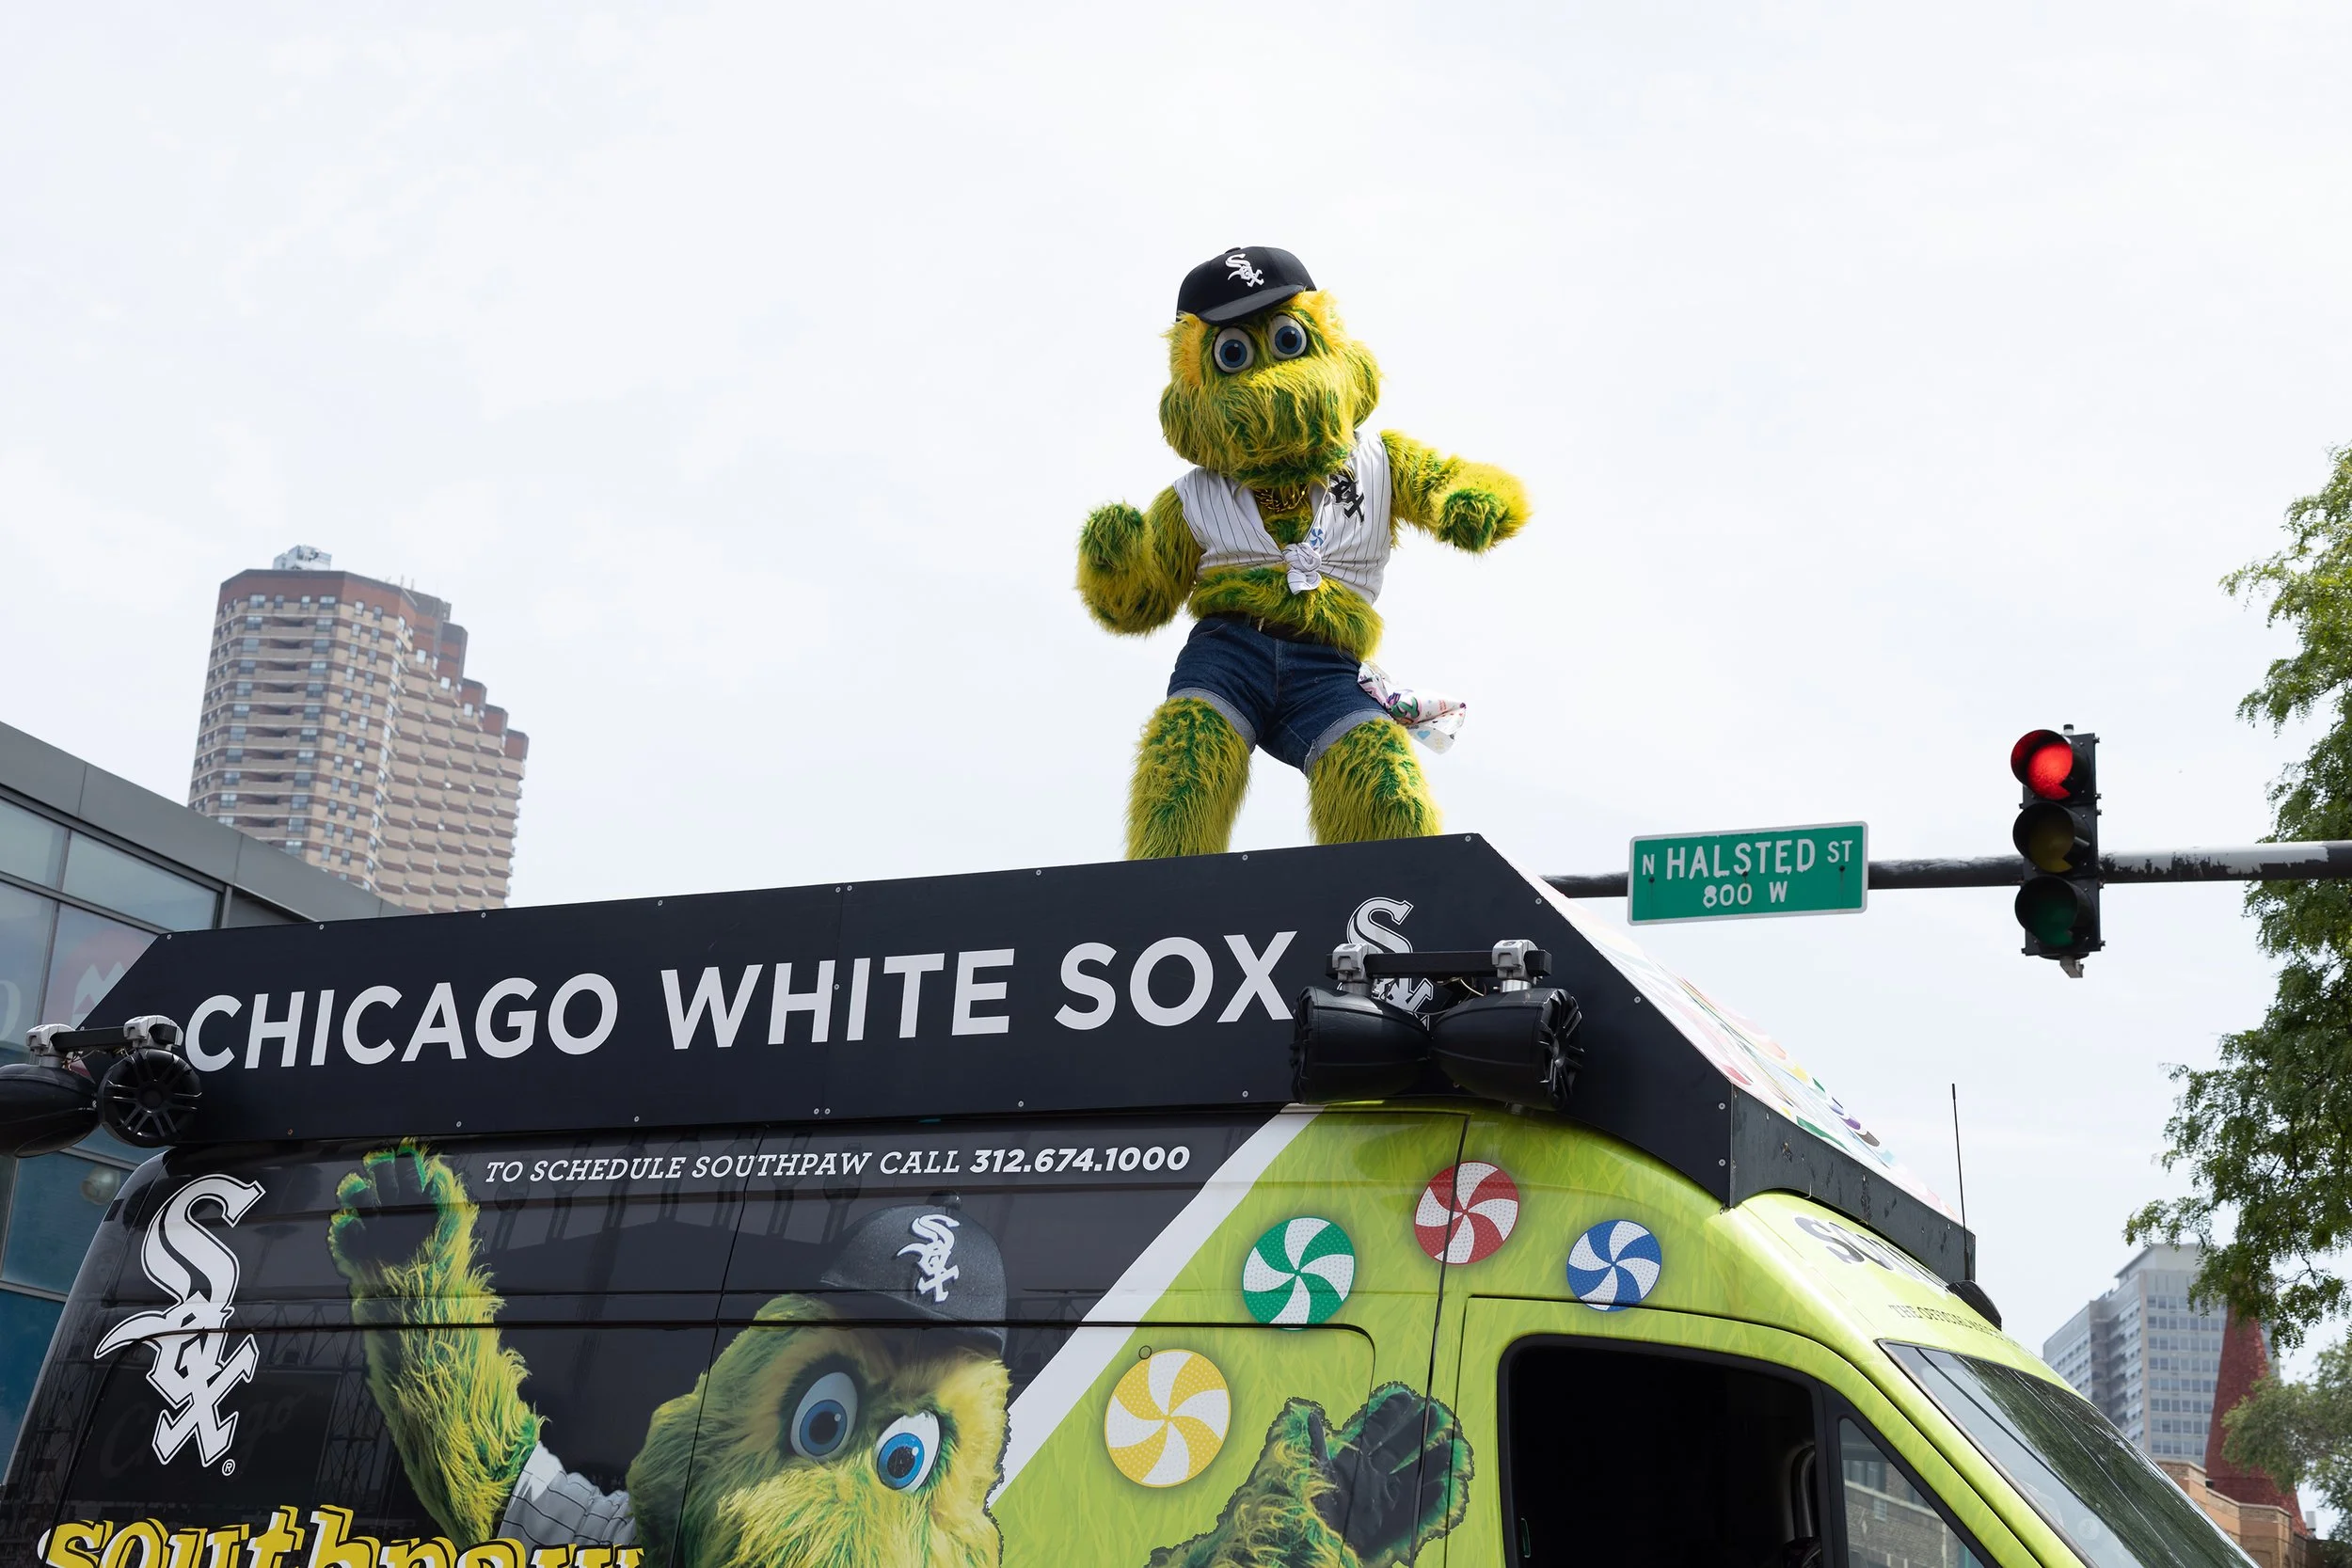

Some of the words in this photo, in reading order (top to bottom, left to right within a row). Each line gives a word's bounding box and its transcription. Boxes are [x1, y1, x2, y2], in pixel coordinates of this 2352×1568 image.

[1642, 854, 1655, 876] N
[1666, 839, 1816, 880] HALSTED
[1827, 840, 1853, 863] ST
[1703, 882, 1753, 909] 800
[1770, 881, 1788, 903] W
[184, 973, 618, 1072] CHICAGO
[660, 948, 1015, 1050] WHITE
[1054, 930, 1297, 1030] SOX
[485, 1162, 523, 1182] TO
[530, 1156, 687, 1182] SCHEDULE
[692, 1151, 873, 1179] SOUTHPAW
[880, 1150, 961, 1175] CALL
[970, 1147, 1190, 1173] 312.674.1000
